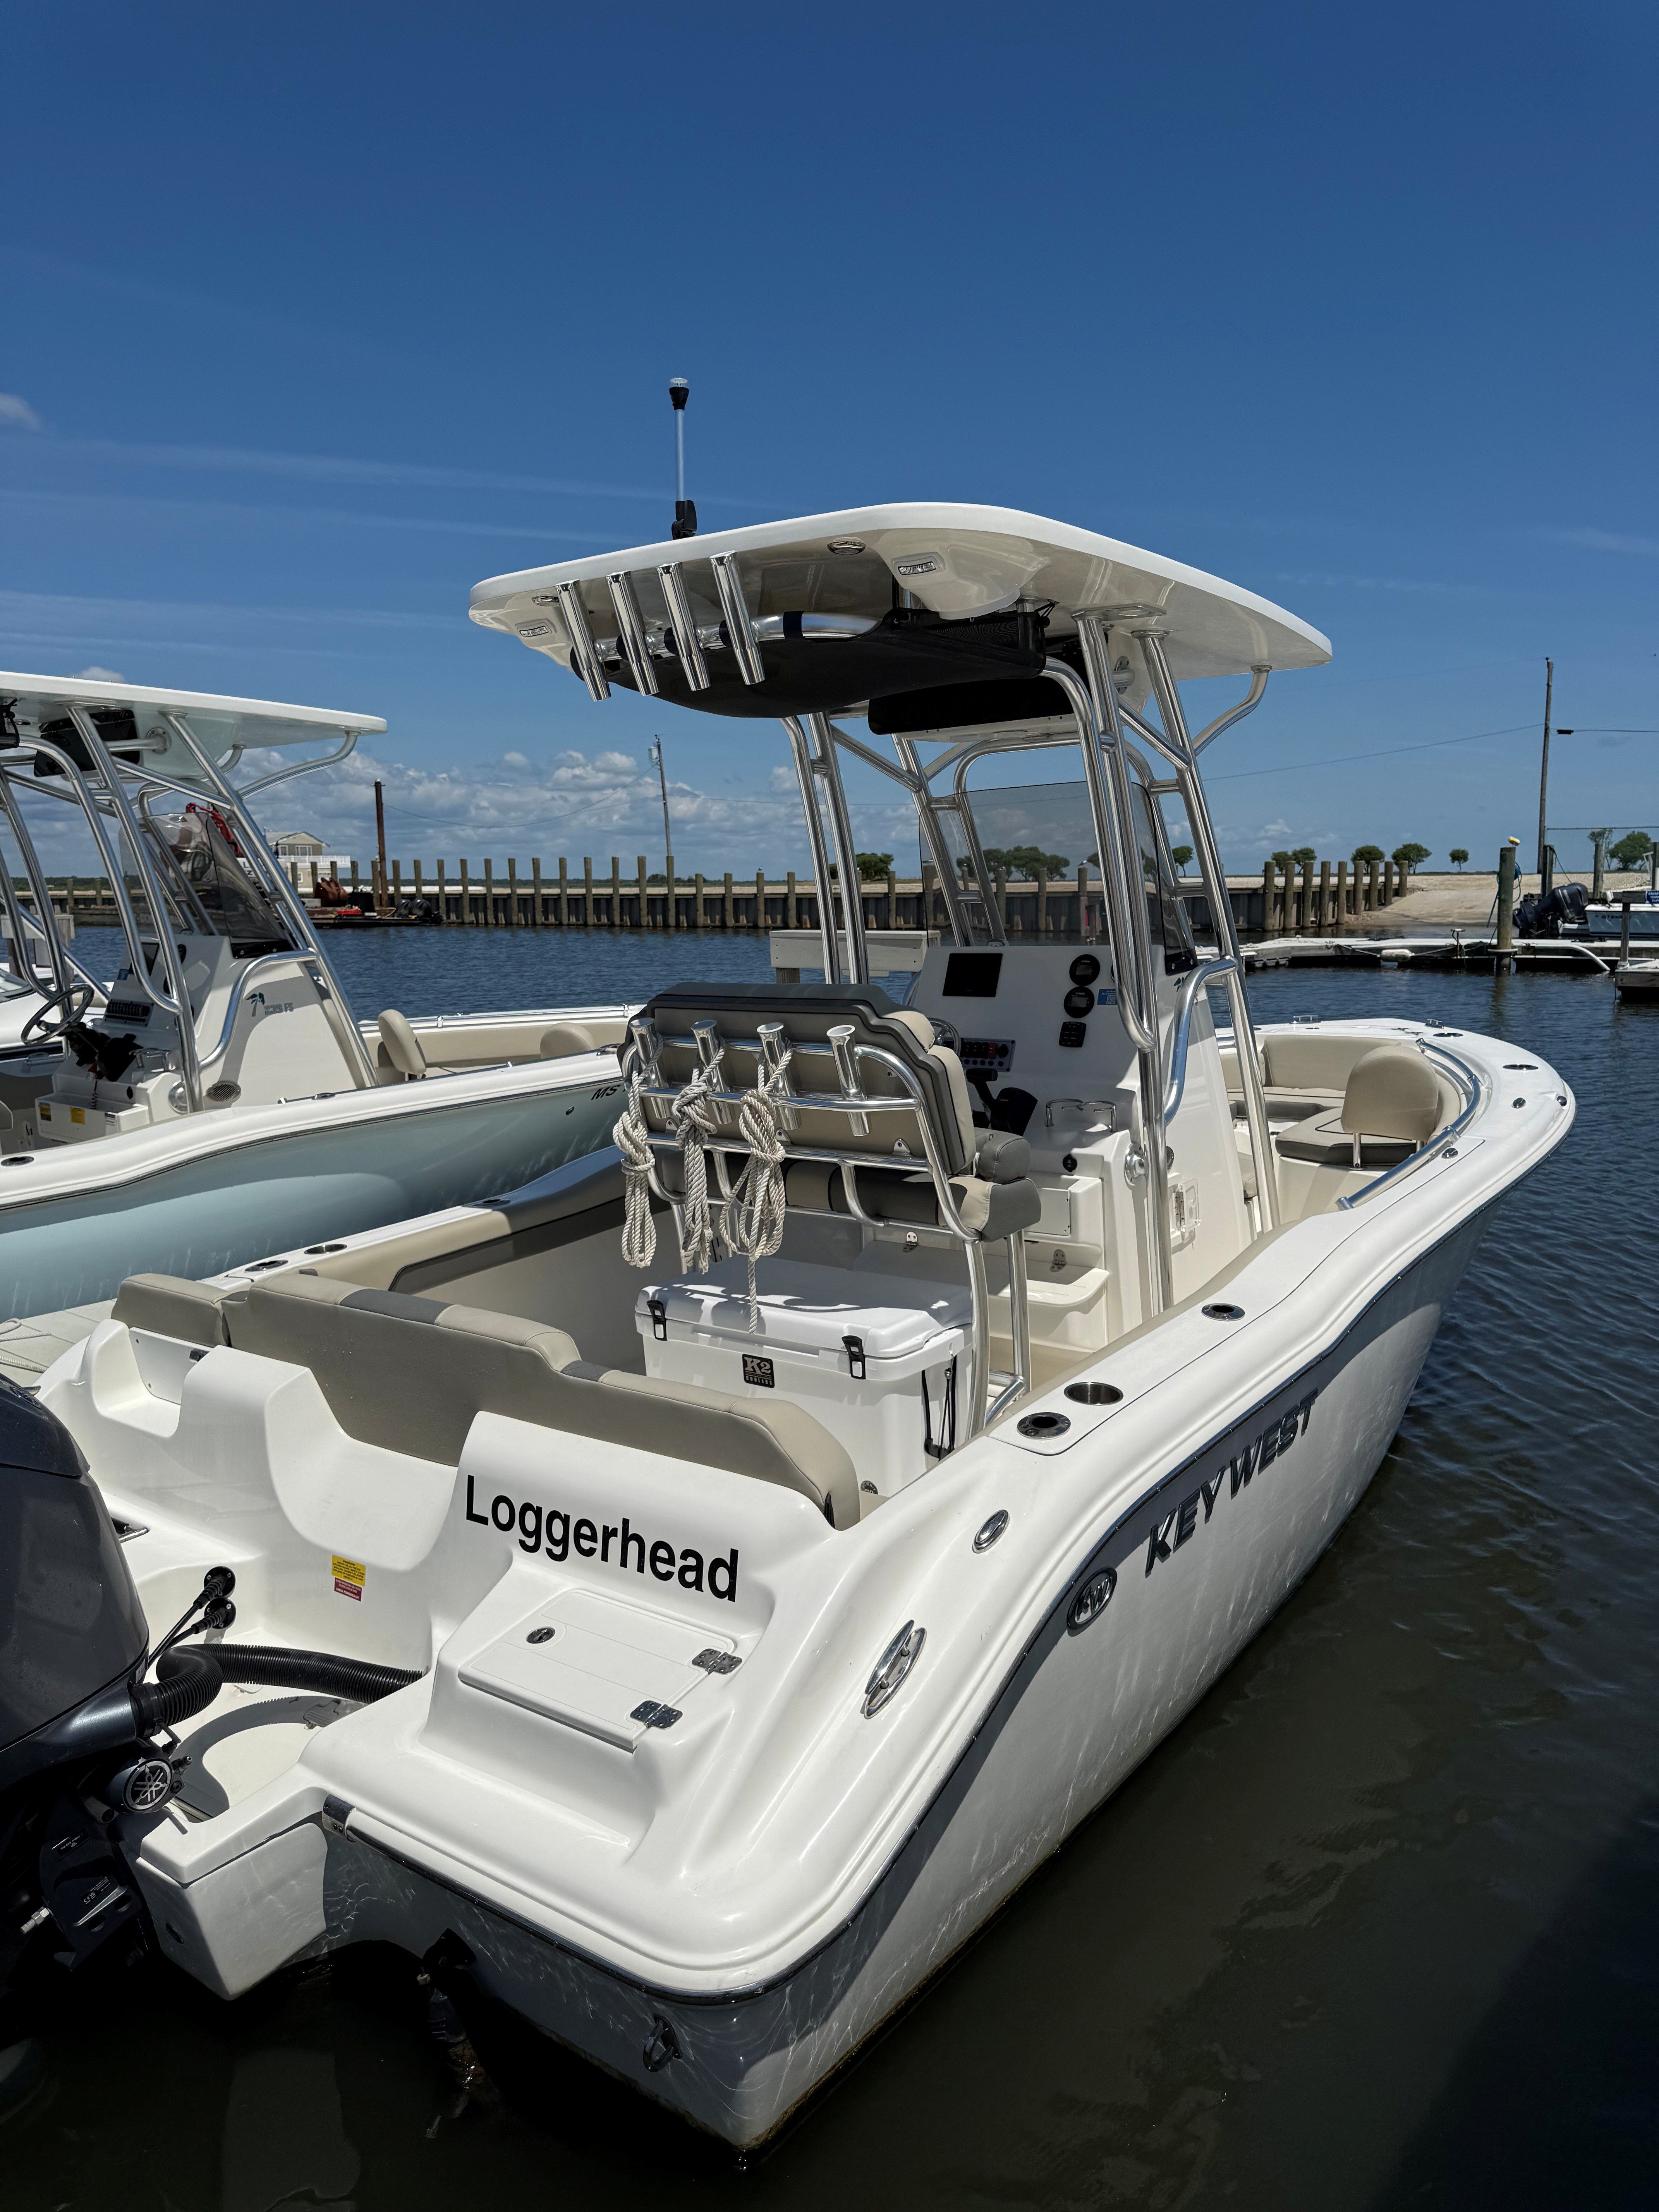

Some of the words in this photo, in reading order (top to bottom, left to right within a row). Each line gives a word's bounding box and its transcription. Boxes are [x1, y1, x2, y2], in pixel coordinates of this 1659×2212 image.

[591, 1085, 621, 1100] MS
[744, 1357, 771, 1375] K2
[1145, 1465, 1226, 1575] KEY
[1230, 1387, 1318, 1498] WEST
[466, 1474, 739, 1602] Loggerhead
[1075, 1578, 1111, 1620] KW
